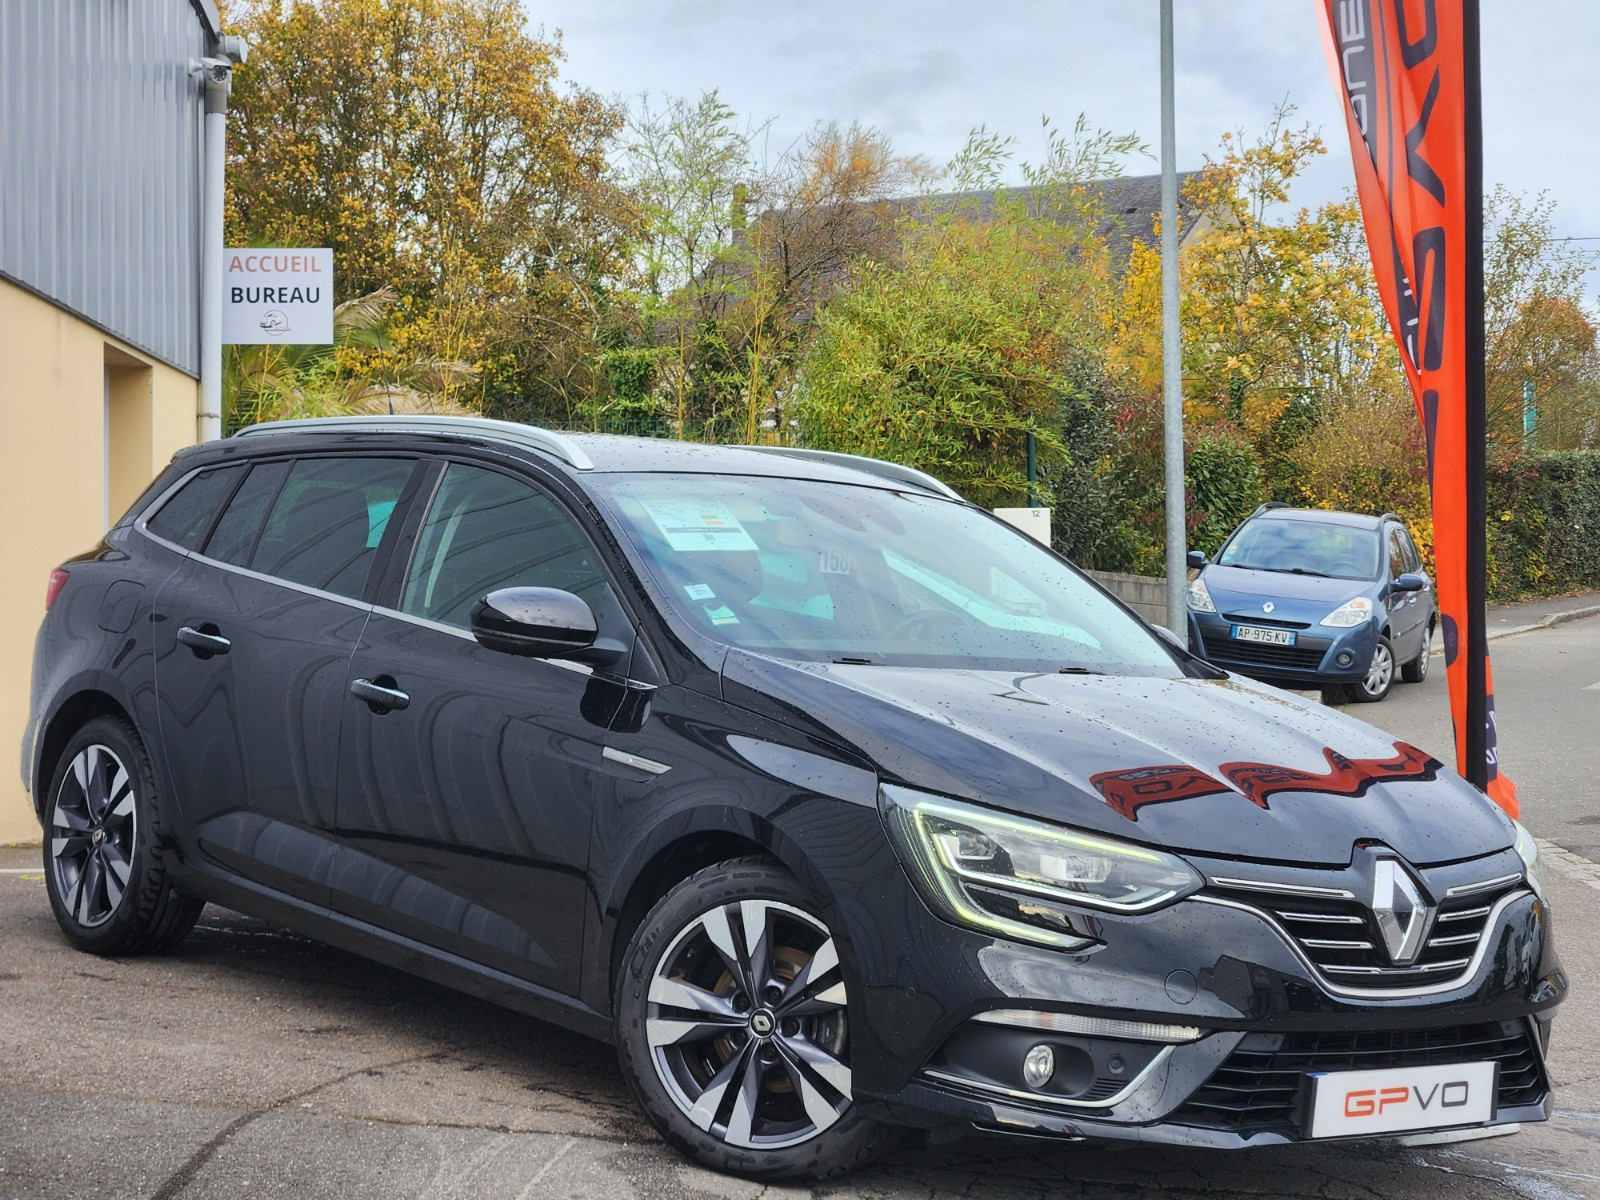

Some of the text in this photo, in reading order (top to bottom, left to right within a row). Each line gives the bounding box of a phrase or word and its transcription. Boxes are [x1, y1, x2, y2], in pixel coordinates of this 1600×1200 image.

[228, 256, 322, 273] ACCUEIL
[231, 287, 320, 304] BUREAU
[1031, 509, 1041, 518] 12
[822, 549, 849, 573] 158
[1344, 1080, 1469, 1118] GPVO
